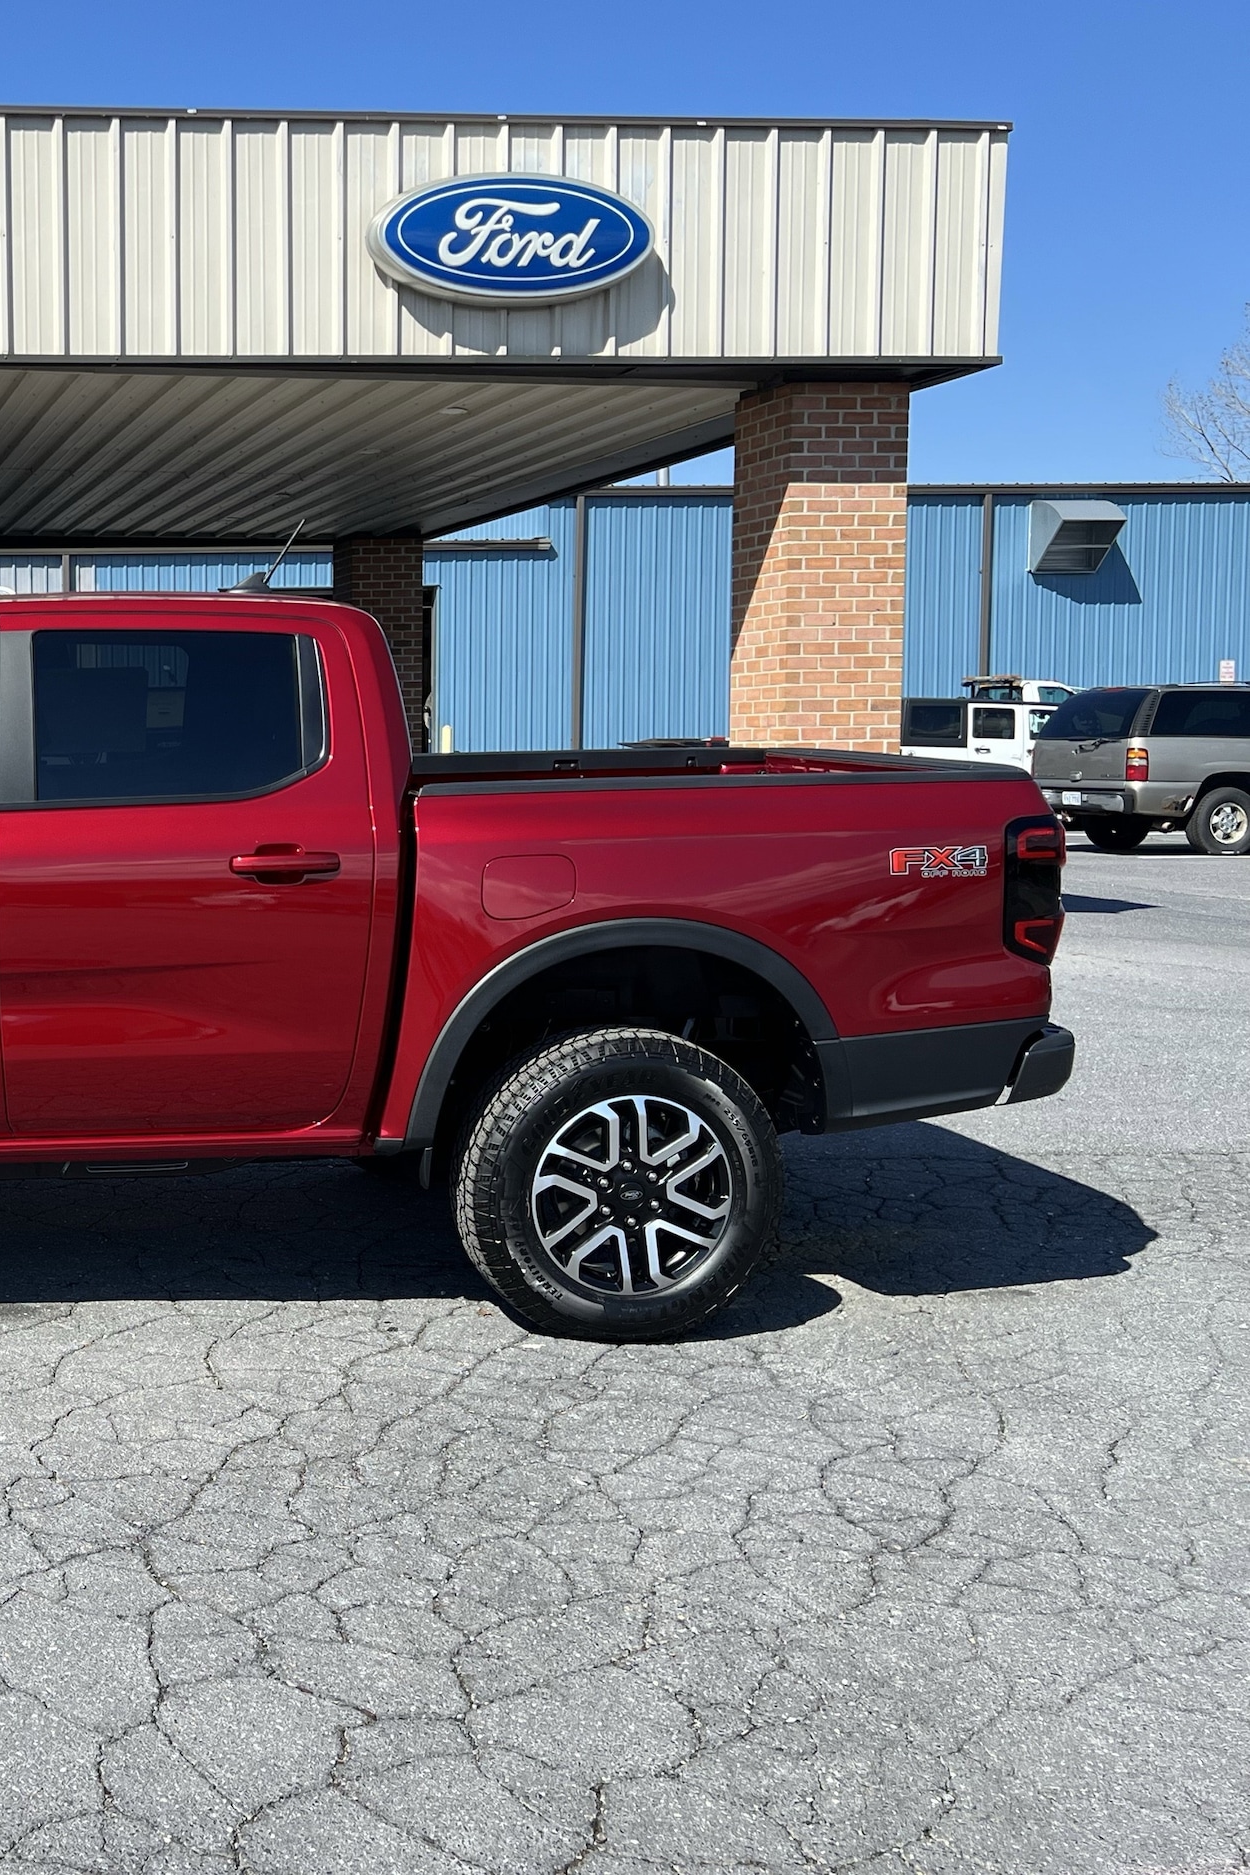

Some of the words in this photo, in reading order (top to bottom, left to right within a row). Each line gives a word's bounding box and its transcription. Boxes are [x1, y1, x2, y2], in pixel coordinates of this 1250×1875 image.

[438, 198, 601, 267] Ford
[889, 846, 988, 875] FX4
[921, 870, 949, 878] OFF
[952, 869, 987, 877] ROAD
[515, 1241, 564, 1300] TERRITORY
